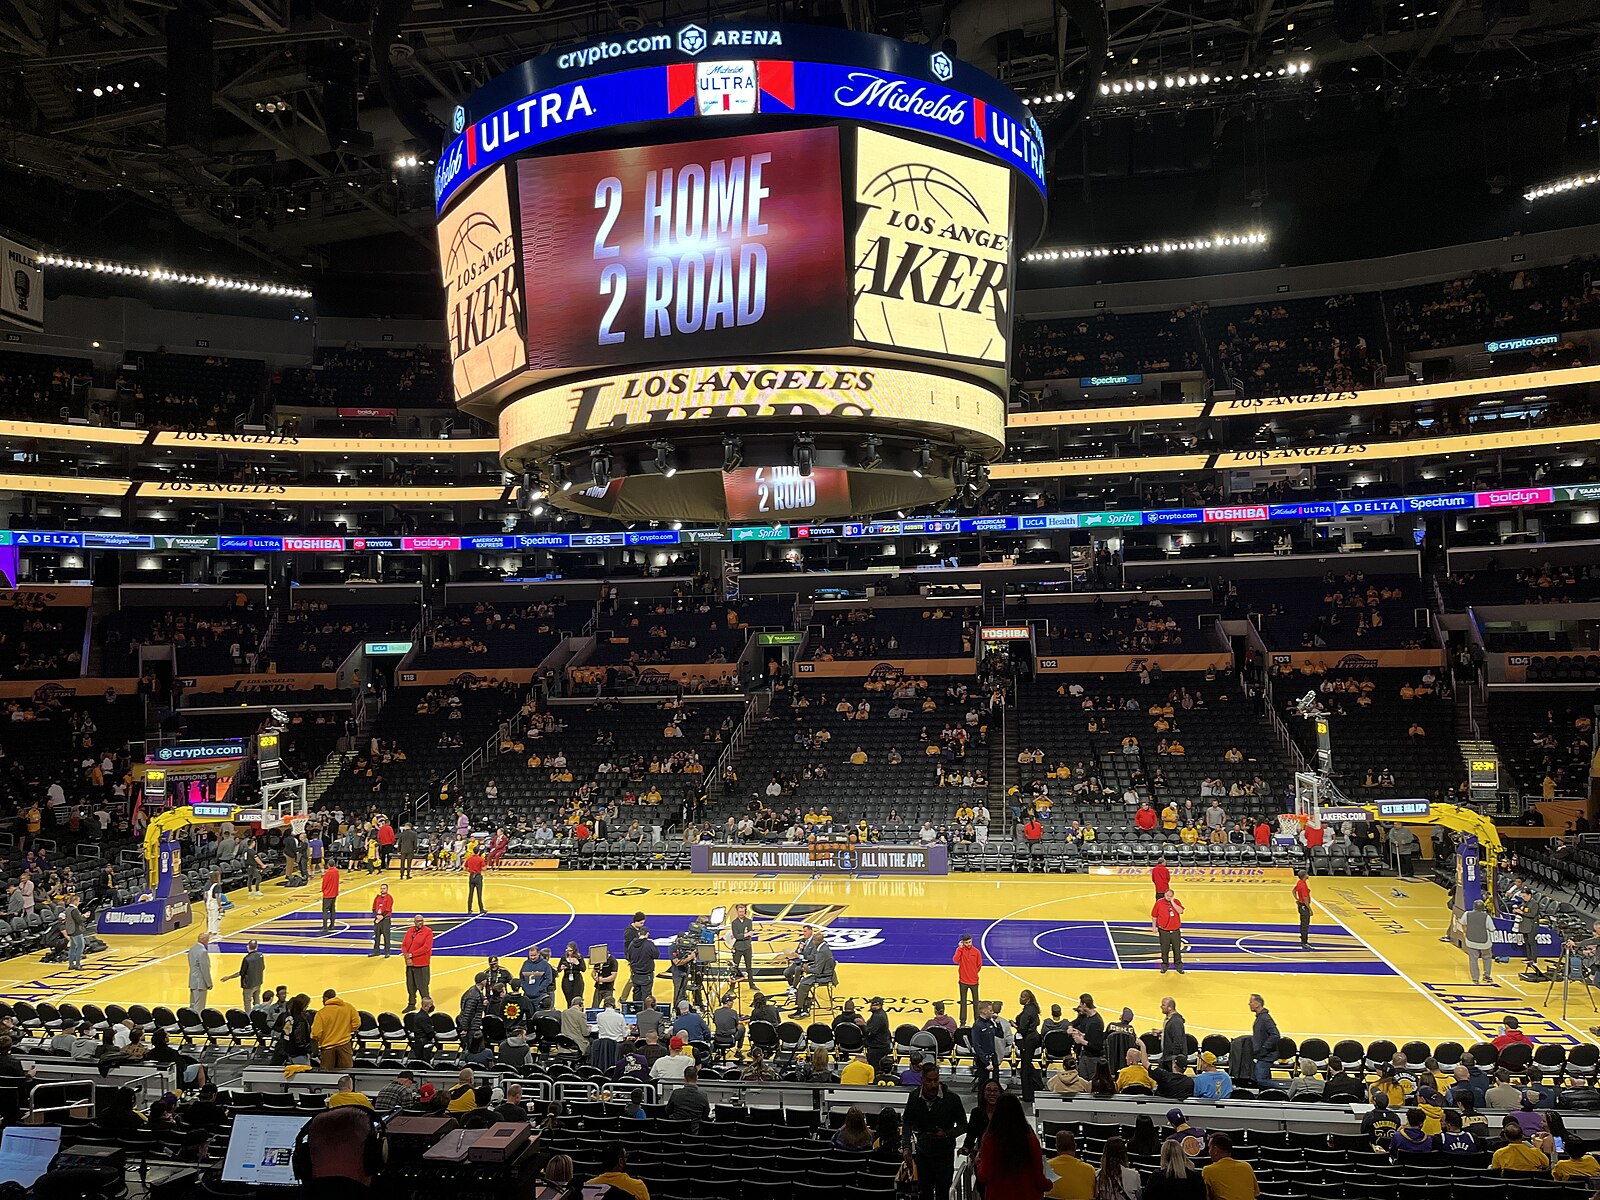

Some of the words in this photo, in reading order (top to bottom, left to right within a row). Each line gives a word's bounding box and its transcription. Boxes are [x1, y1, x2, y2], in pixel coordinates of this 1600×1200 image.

[557, 33, 672, 69] crypto.com
[712, 30, 782, 46] ARENA
[700, 76, 754, 92] ULTRA
[834, 72, 967, 126] Michelob
[992, 111, 1046, 186] ULTRA
[594, 175, 623, 260] 2
[643, 152, 771, 251] HOME
[887, 209, 937, 235] LOS
[457, 265, 477, 292] LOS
[598, 263, 628, 345] 2
[643, 242, 768, 339] ROAD
[1499, 335, 1558, 351] crypto.com
[622, 374, 688, 401] LOS
[693, 368, 875, 394] ANGELES
[1091, 376, 1127, 386] Spectrum
[1230, 398, 1263, 409] LOS
[173, 432, 209, 442] LOS
[1233, 450, 1270, 461] LOS
[1275, 444, 1367, 459] ANGELES
[157, 482, 192, 491] LOS
[757, 484, 770, 513] 2
[773, 479, 816, 511] ROAD
[1489, 490, 1539, 503] boldyn
[1354, 501, 1399, 512] DELTA
[1410, 497, 1465, 510] Spectrum
[1206, 507, 1266, 521] TOSHIBA
[1303, 505, 1331, 514] ULTRA
[1048, 517, 1076, 526] Health
[1107, 513, 1136, 525] Sprite
[1158, 512, 1197, 522] crypto.com
[758, 528, 783, 538] Sprite
[810, 527, 835, 535] TOYOTA
[32, 534, 79, 544] DELTA
[520, 535, 563, 545] Spectrum
[586, 535, 611, 544] 6:35
[639, 533, 673, 541] crypto.com
[285, 539, 341, 549] TOSHIBA
[413, 538, 451, 549] boldyn
[983, 629, 1028, 638] TOSHIBA
[1042, 660, 1056, 668] 102
[173, 745, 242, 758] crypto.com
[1319, 813, 1366, 821] LAKERS.COM
[712, 852, 726, 867] ALL
[727, 852, 761, 867] ACCESS.
[762, 852, 777, 867] ALL
[861, 852, 877, 867] ALL
[878, 852, 887, 867] IN
[888, 852, 906, 867] THE
[907, 852, 925, 867] APP.
[111, 911, 121, 923] NBA
[122, 911, 140, 925] League
[140, 911, 155, 923] Pass
[1535, 933, 1552, 945] ass
